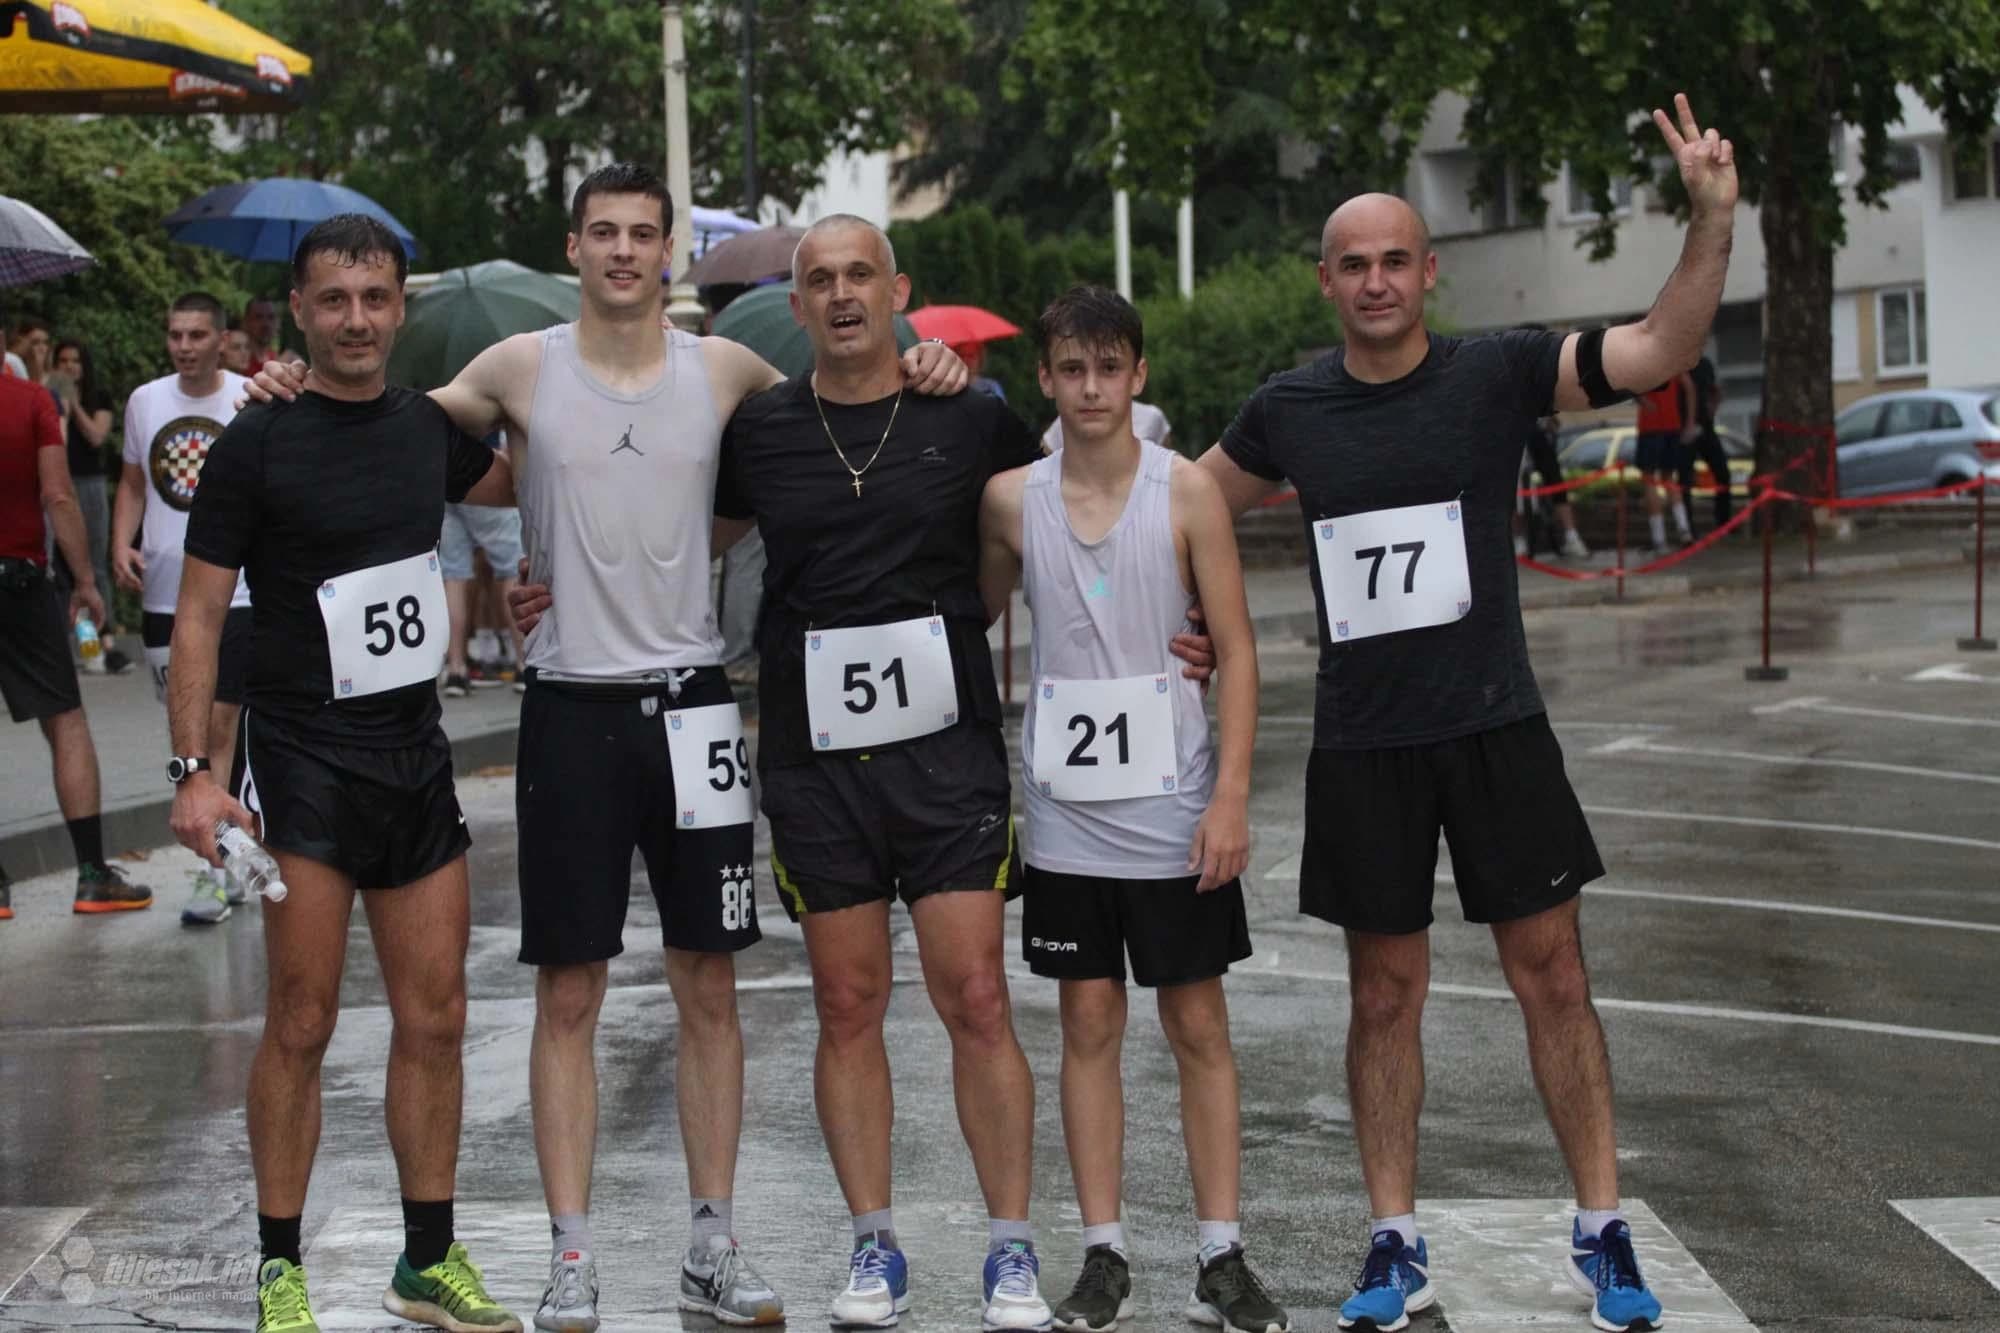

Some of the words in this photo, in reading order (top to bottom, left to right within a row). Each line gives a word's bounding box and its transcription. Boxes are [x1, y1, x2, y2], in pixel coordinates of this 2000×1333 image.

[1355, 541, 1425, 600] 77
[364, 595, 425, 656] 58
[843, 657, 909, 714] 51
[708, 737, 751, 791] 59
[1066, 712, 1129, 766] 21
